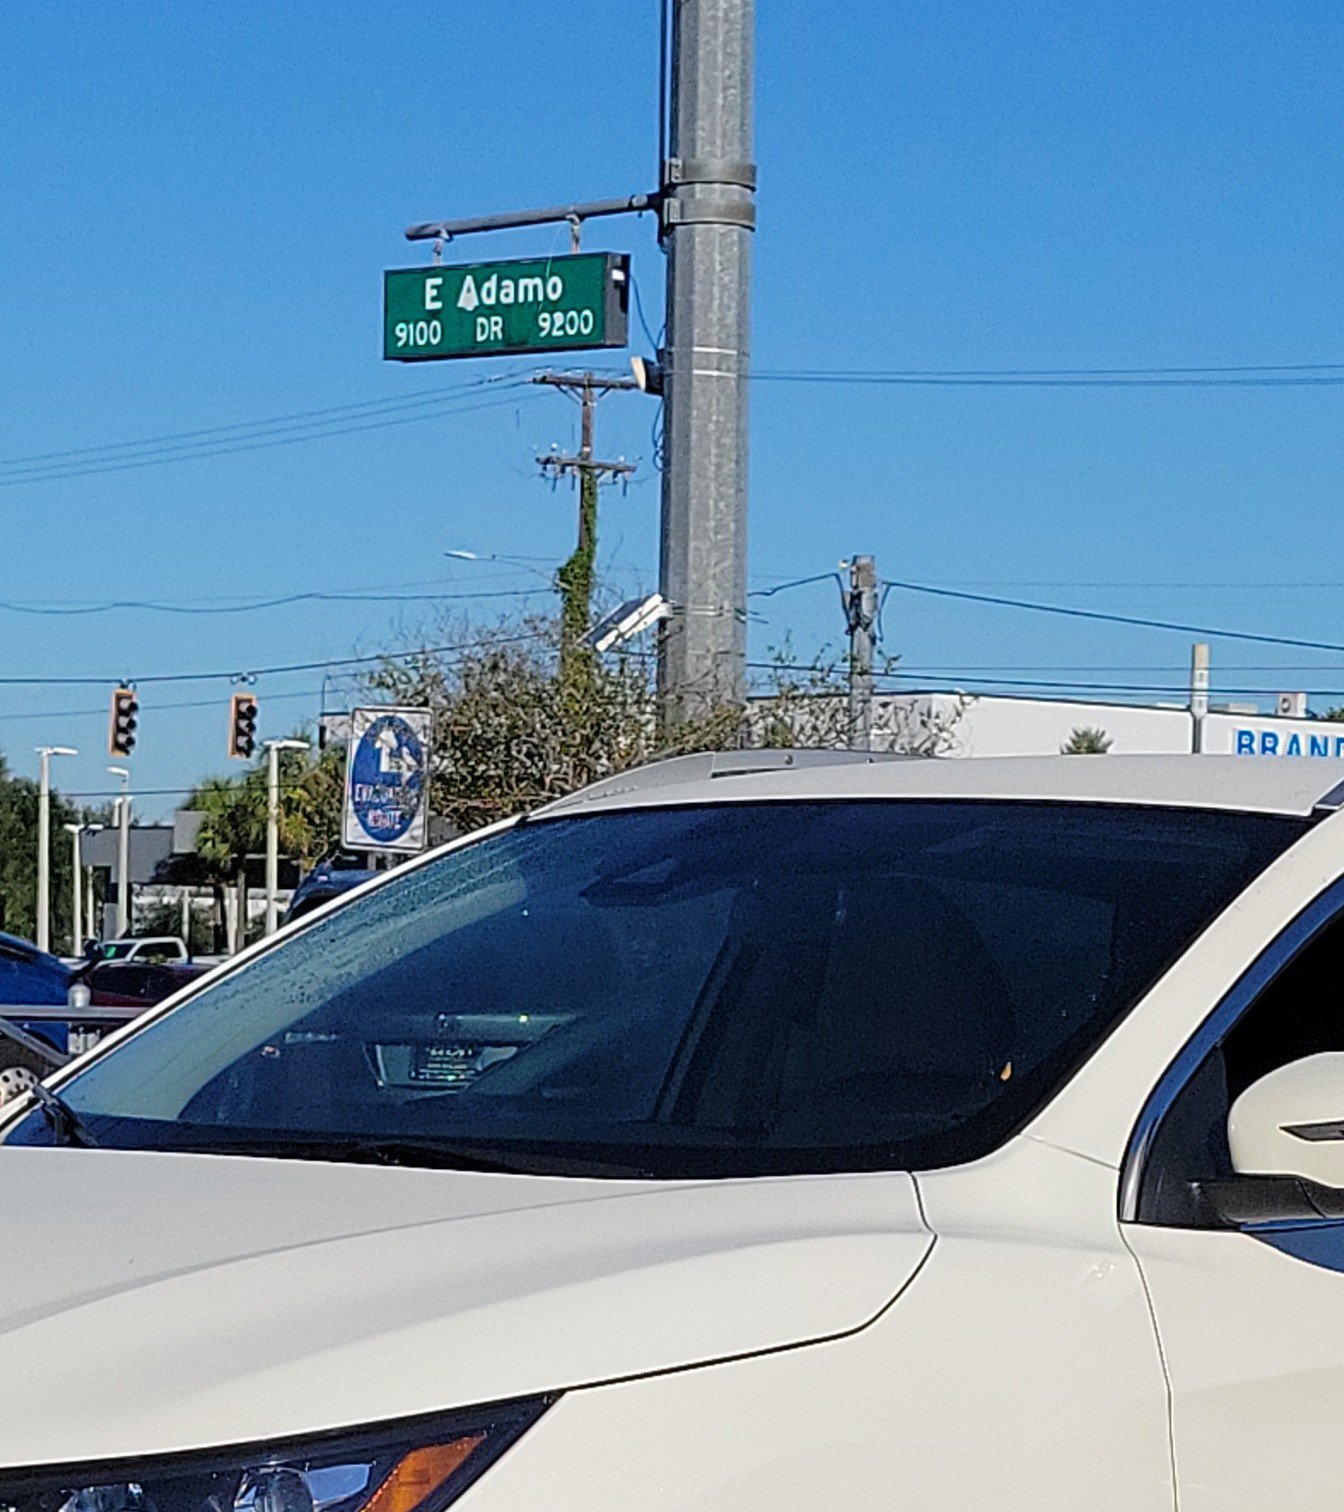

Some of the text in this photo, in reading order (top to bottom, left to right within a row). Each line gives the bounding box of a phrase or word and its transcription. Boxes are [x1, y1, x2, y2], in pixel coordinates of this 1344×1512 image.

[424, 273, 563, 310] E Adamo
[395, 309, 593, 347] 9100 DR 9200
